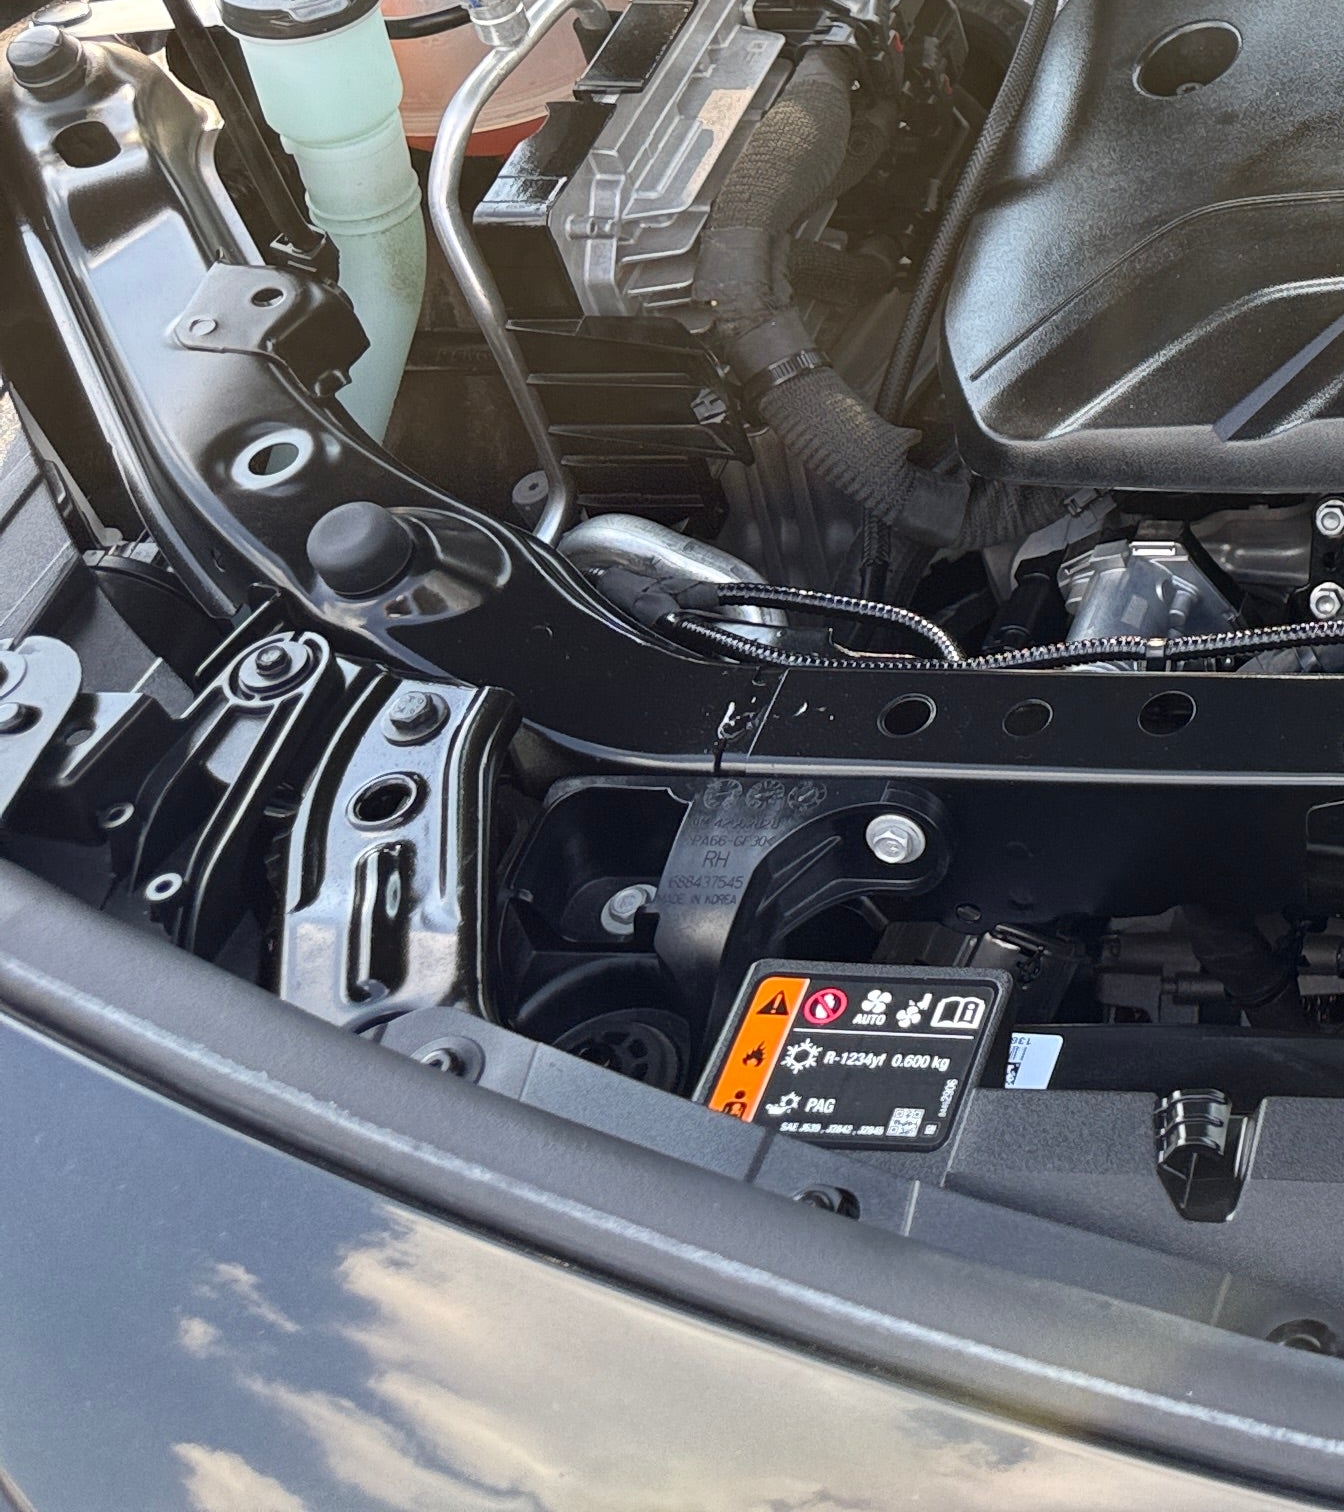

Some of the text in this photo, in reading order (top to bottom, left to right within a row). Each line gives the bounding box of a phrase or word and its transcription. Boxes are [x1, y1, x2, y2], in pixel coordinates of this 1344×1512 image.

[702, 850, 730, 868] RH
[705, 895, 737, 905] KOREA
[852, 1013, 887, 1026] AUTO
[823, 1050, 950, 1072] R-1234yf 0.600 kg
[805, 1097, 836, 1114] PAG
[779, 1121, 799, 1133] SAE
